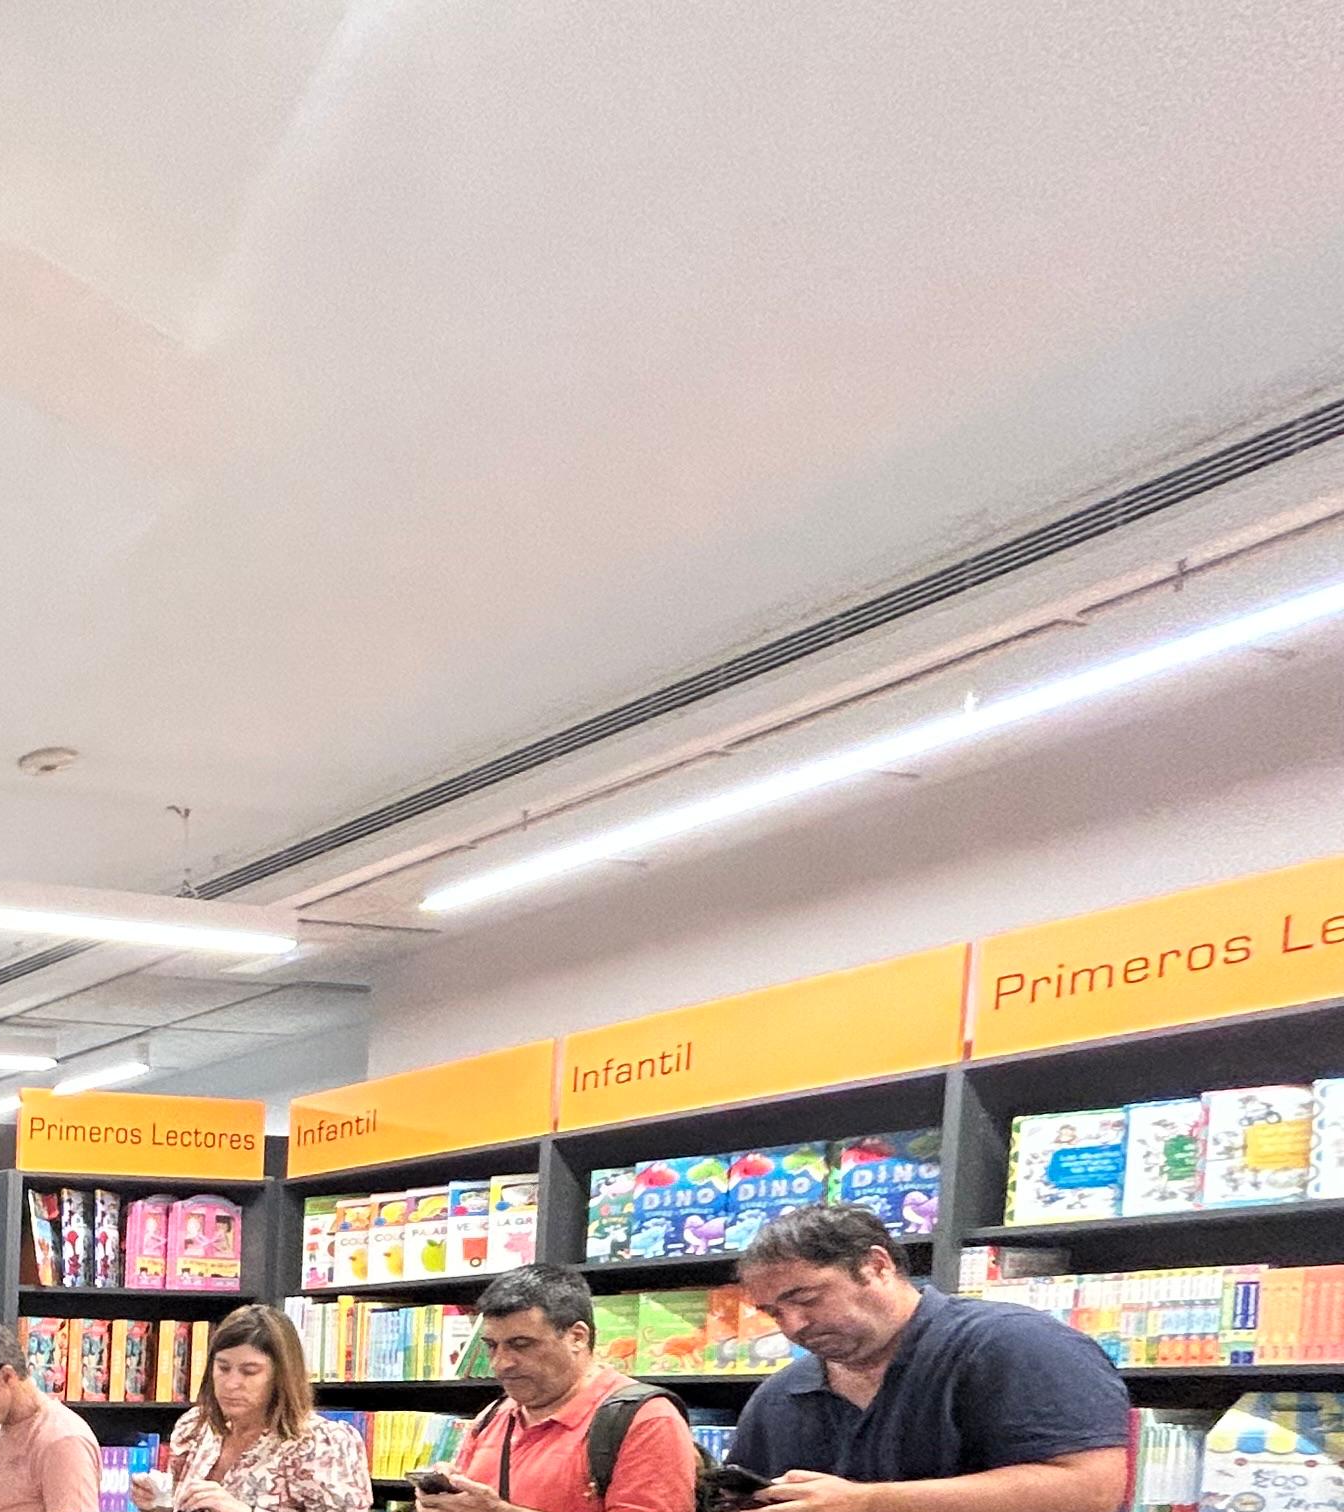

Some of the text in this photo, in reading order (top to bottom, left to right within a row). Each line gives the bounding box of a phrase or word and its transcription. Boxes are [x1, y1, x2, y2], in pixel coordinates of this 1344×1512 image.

[994, 932, 1253, 1011] Primeros
[571, 1042, 693, 1093] Infantil
[29, 1116, 256, 1152] Primeros Lectores
[296, 1109, 378, 1148] Infantil
